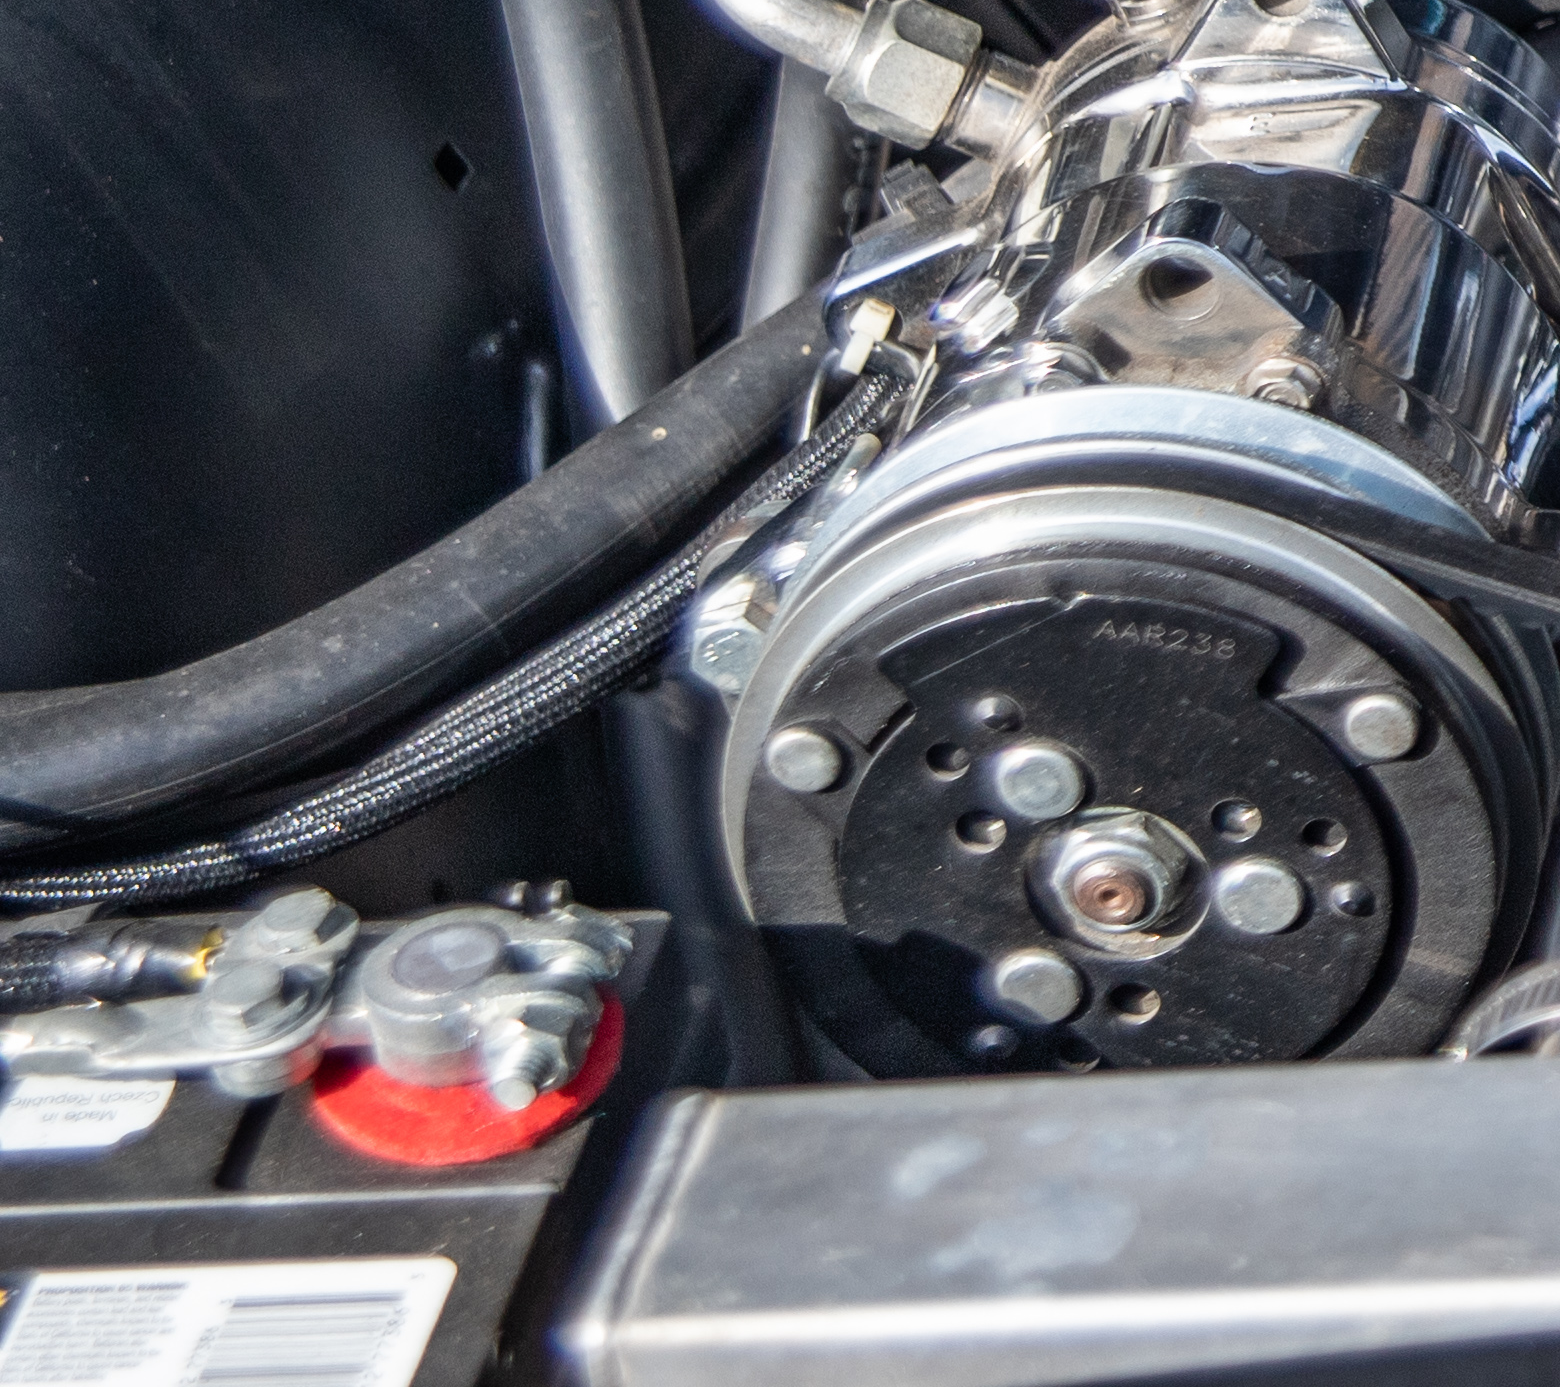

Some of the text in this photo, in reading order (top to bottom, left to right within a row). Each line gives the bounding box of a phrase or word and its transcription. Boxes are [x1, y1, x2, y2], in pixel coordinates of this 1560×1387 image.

[1092, 619, 1236, 660] AAR238
[9, 1090, 161, 1108] Czech Republic
[42, 1109, 118, 1124] Made in
